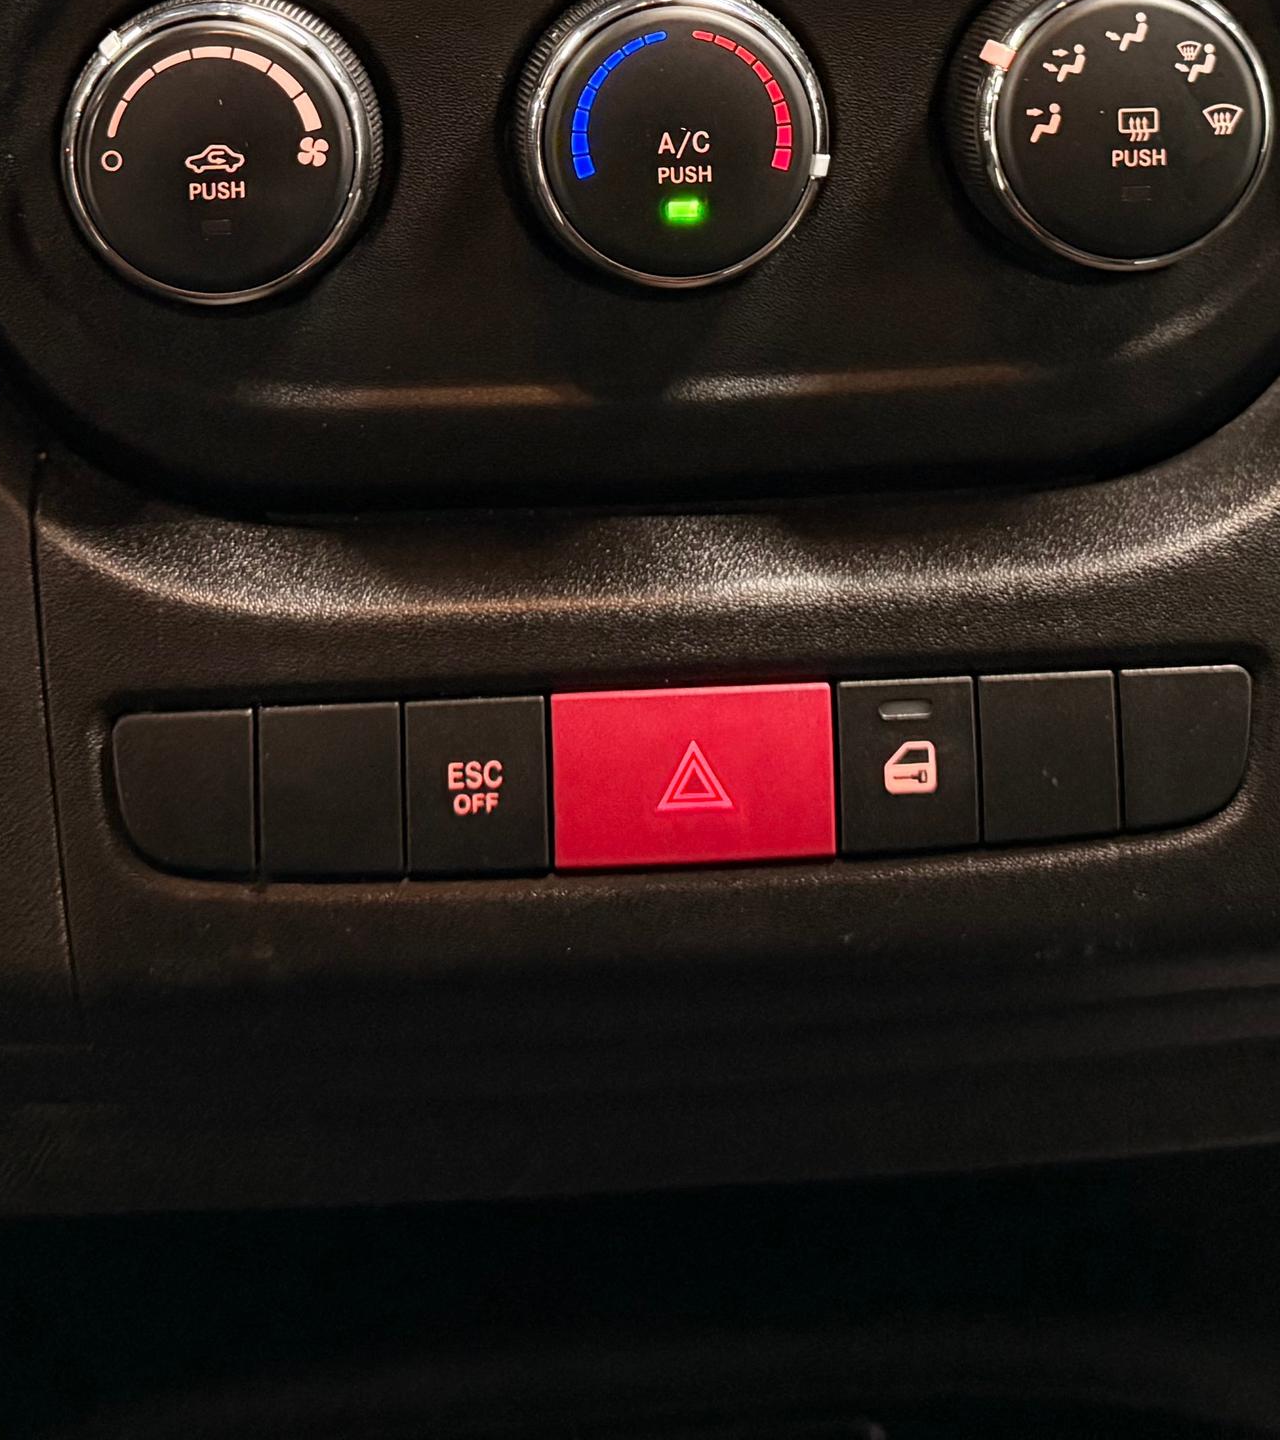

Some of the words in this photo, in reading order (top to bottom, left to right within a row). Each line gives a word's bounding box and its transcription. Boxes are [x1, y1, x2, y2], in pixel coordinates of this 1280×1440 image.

[657, 128, 711, 157] A/C
[1111, 147, 1168, 168] PUSH
[656, 165, 713, 185] PUSH
[188, 179, 247, 202] PUSH
[446, 759, 504, 793] ESC
[452, 793, 500, 816] OFF
